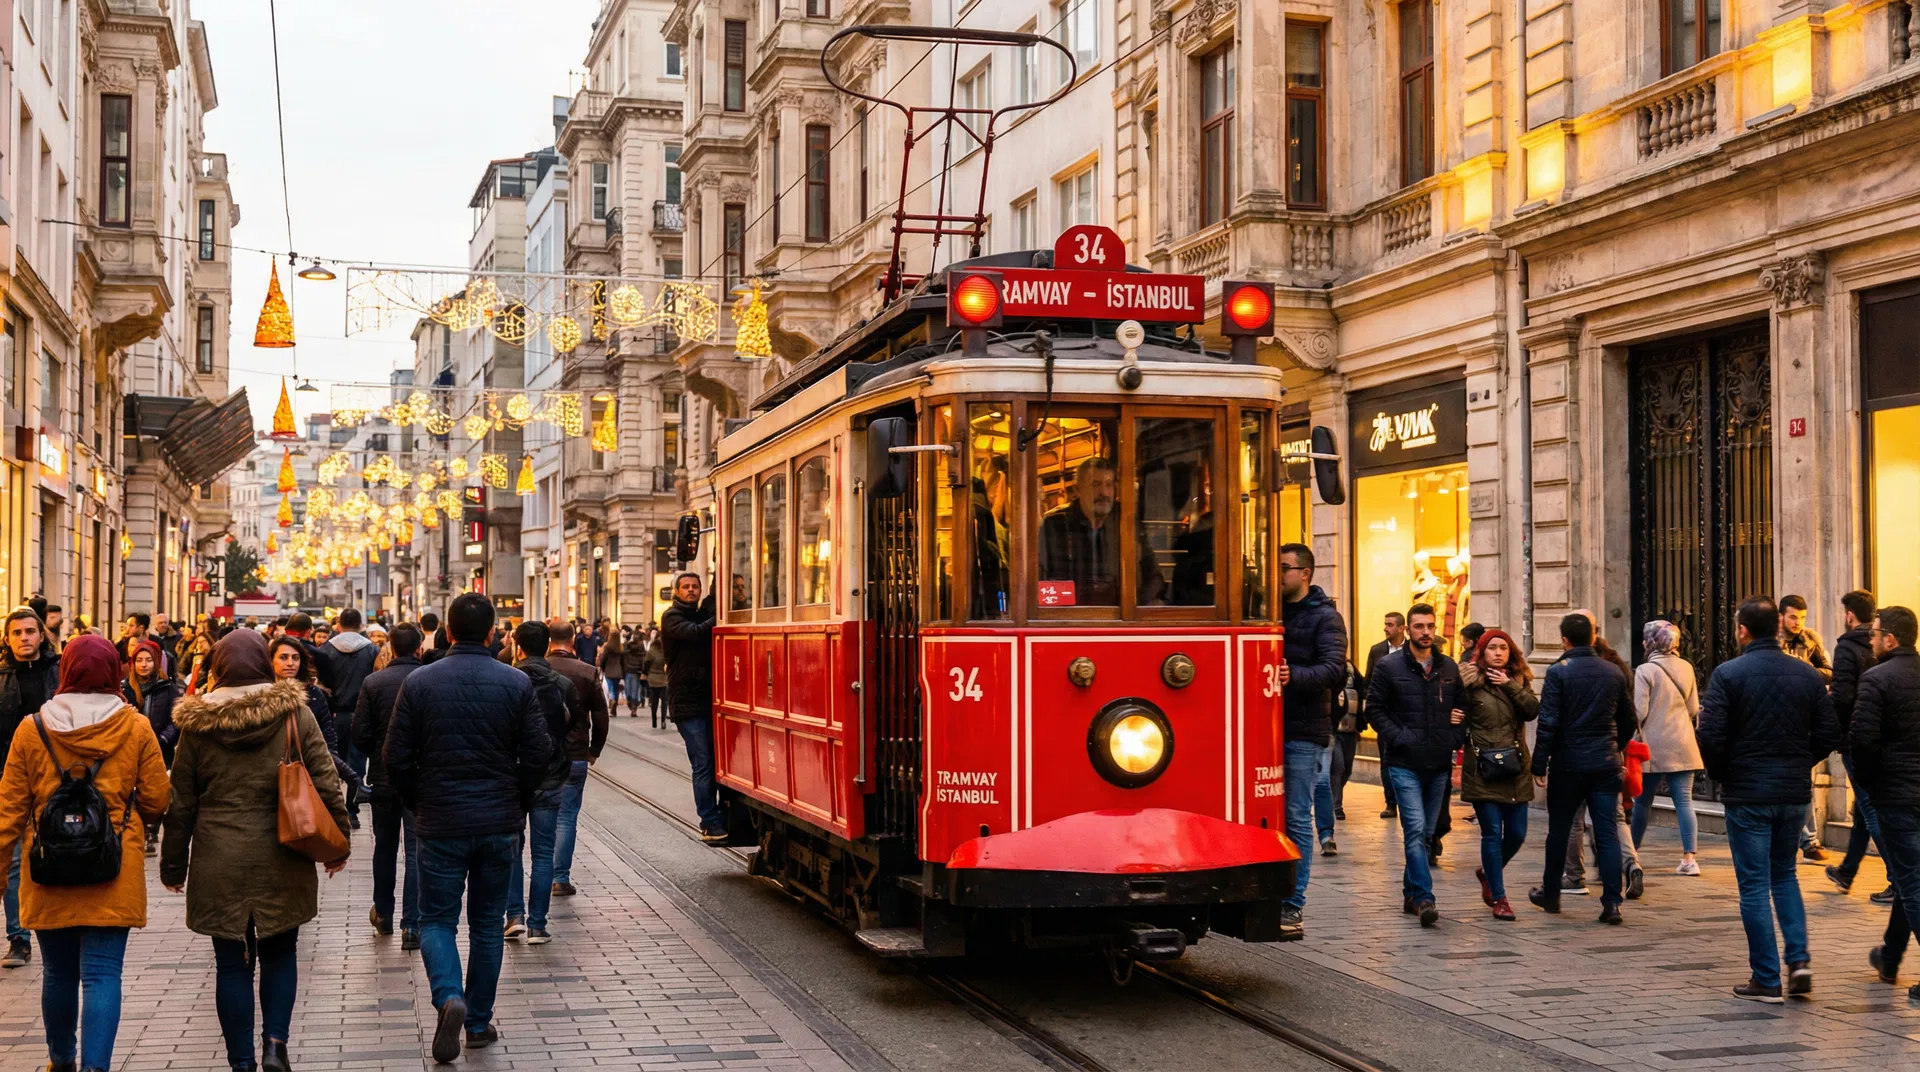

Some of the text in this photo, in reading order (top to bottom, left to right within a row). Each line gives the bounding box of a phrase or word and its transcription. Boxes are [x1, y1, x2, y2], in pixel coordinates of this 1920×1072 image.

[1074, 233, 1106, 264] 34
[1002, 280, 1072, 306] RAMVAY
[1107, 278, 1195, 311] İSTANBUL
[949, 666, 983, 702] 34
[1262, 663, 1282, 698] 34
[937, 770, 998, 787] TRAMVAY
[937, 785, 999, 804] İSTANBUL
